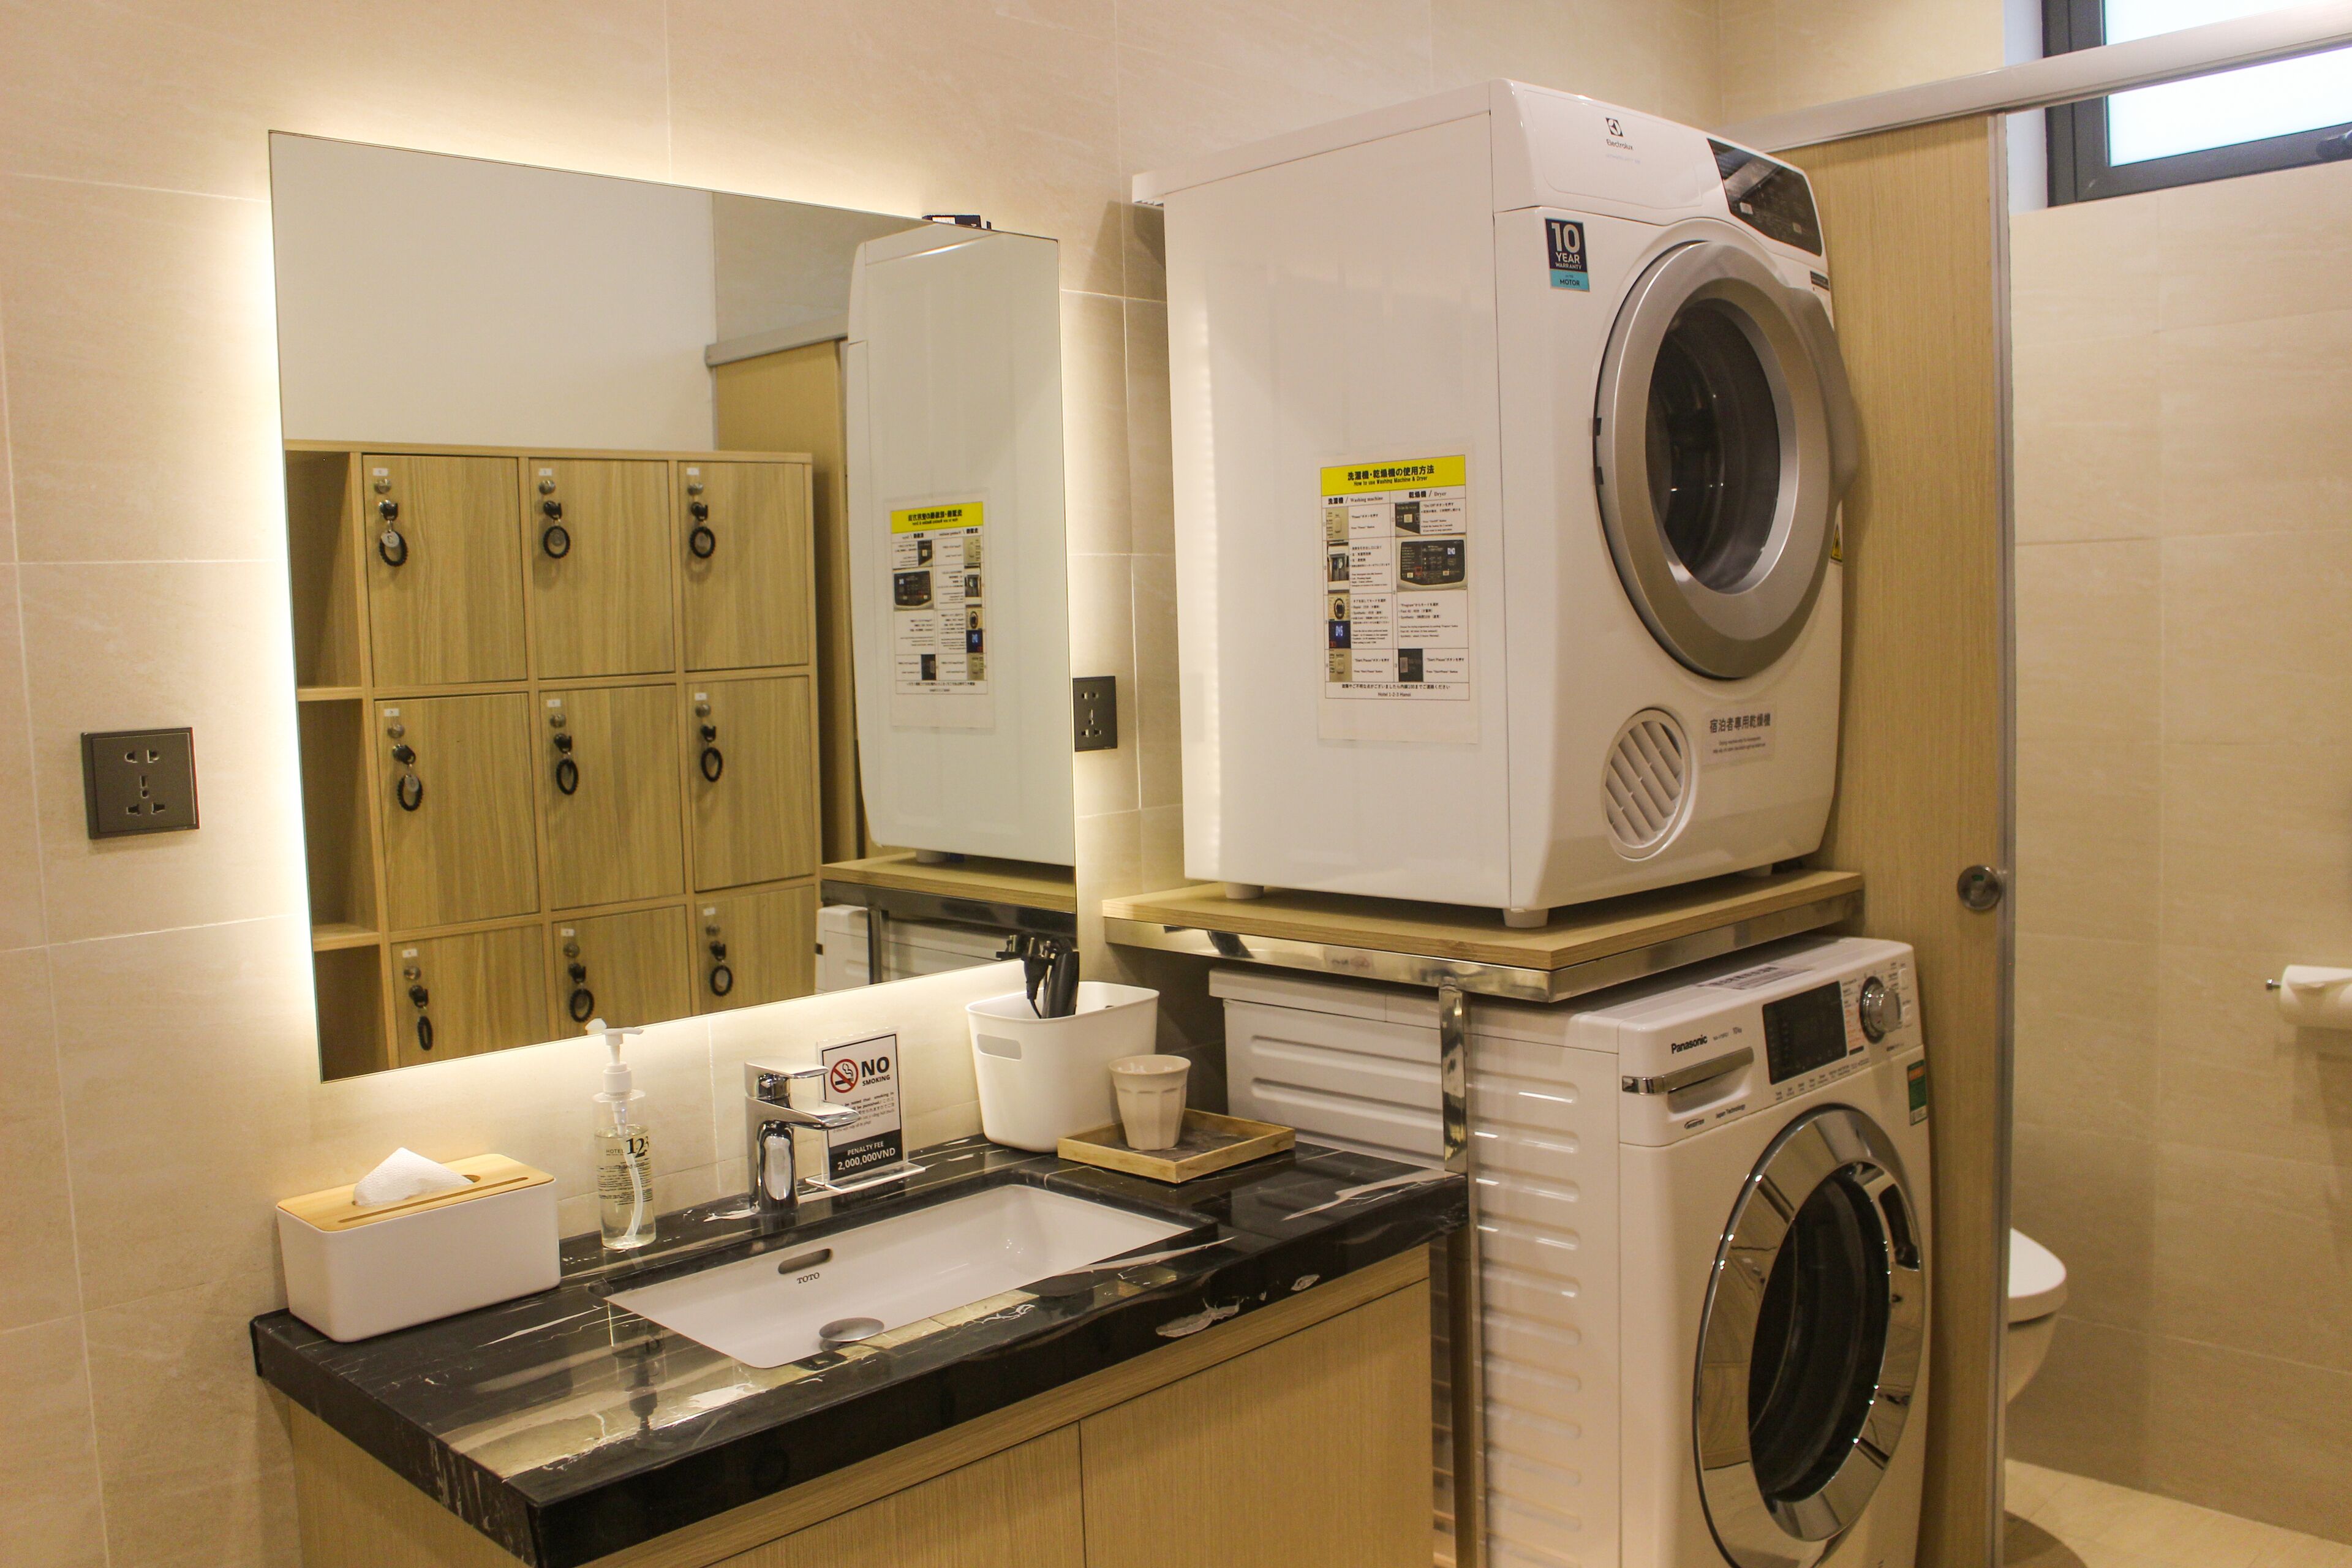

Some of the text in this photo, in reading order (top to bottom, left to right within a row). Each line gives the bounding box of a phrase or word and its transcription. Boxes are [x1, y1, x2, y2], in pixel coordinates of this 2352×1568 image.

[1606, 138, 1634, 151] Electrolux
[1551, 222, 1580, 254] 10
[1555, 251, 1580, 264] YEAR
[1671, 1034, 1708, 1055] Panasonic
[861, 1056, 890, 1078] NO
[862, 1074, 891, 1087] SMOKING
[1725, 1104, 1746, 1114] Technology
[846, 1140, 884, 1156] PENALTY FEE
[837, 1147, 896, 1171] 2,000,000VND
[797, 1272, 820, 1284] TOTO
